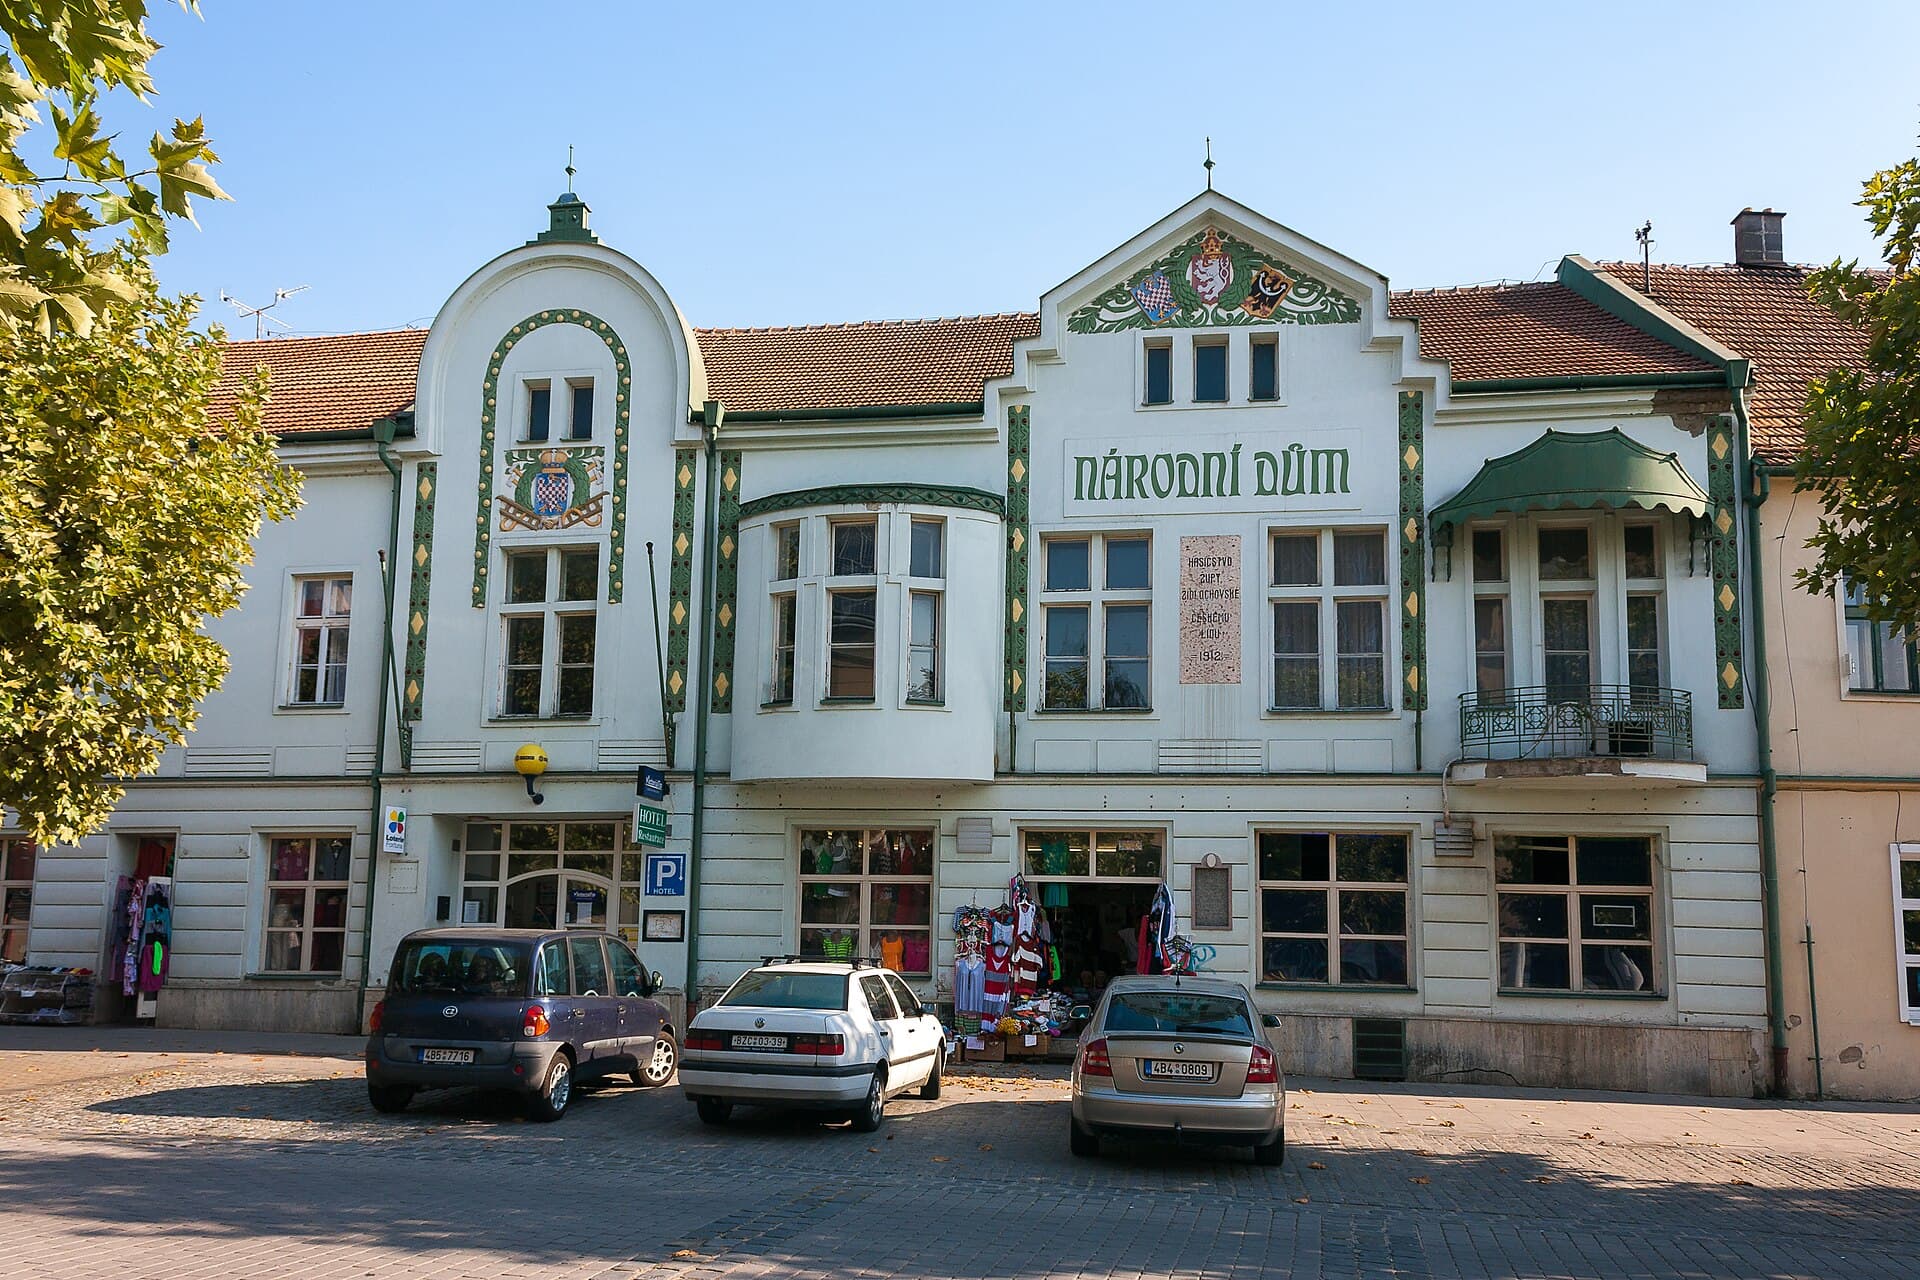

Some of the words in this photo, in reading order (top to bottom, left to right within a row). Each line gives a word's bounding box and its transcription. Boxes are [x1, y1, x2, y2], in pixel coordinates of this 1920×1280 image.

[1073, 444, 1242, 500] NÁRODNÍ
[1254, 443, 1351, 496] DŮM
[640, 808, 666, 827] HOTEL
[656, 861, 676, 887] P
[447, 1051, 470, 1061] 7716
[1153, 1062, 1174, 1074] 4B4
[1181, 1064, 1208, 1076] 0809
